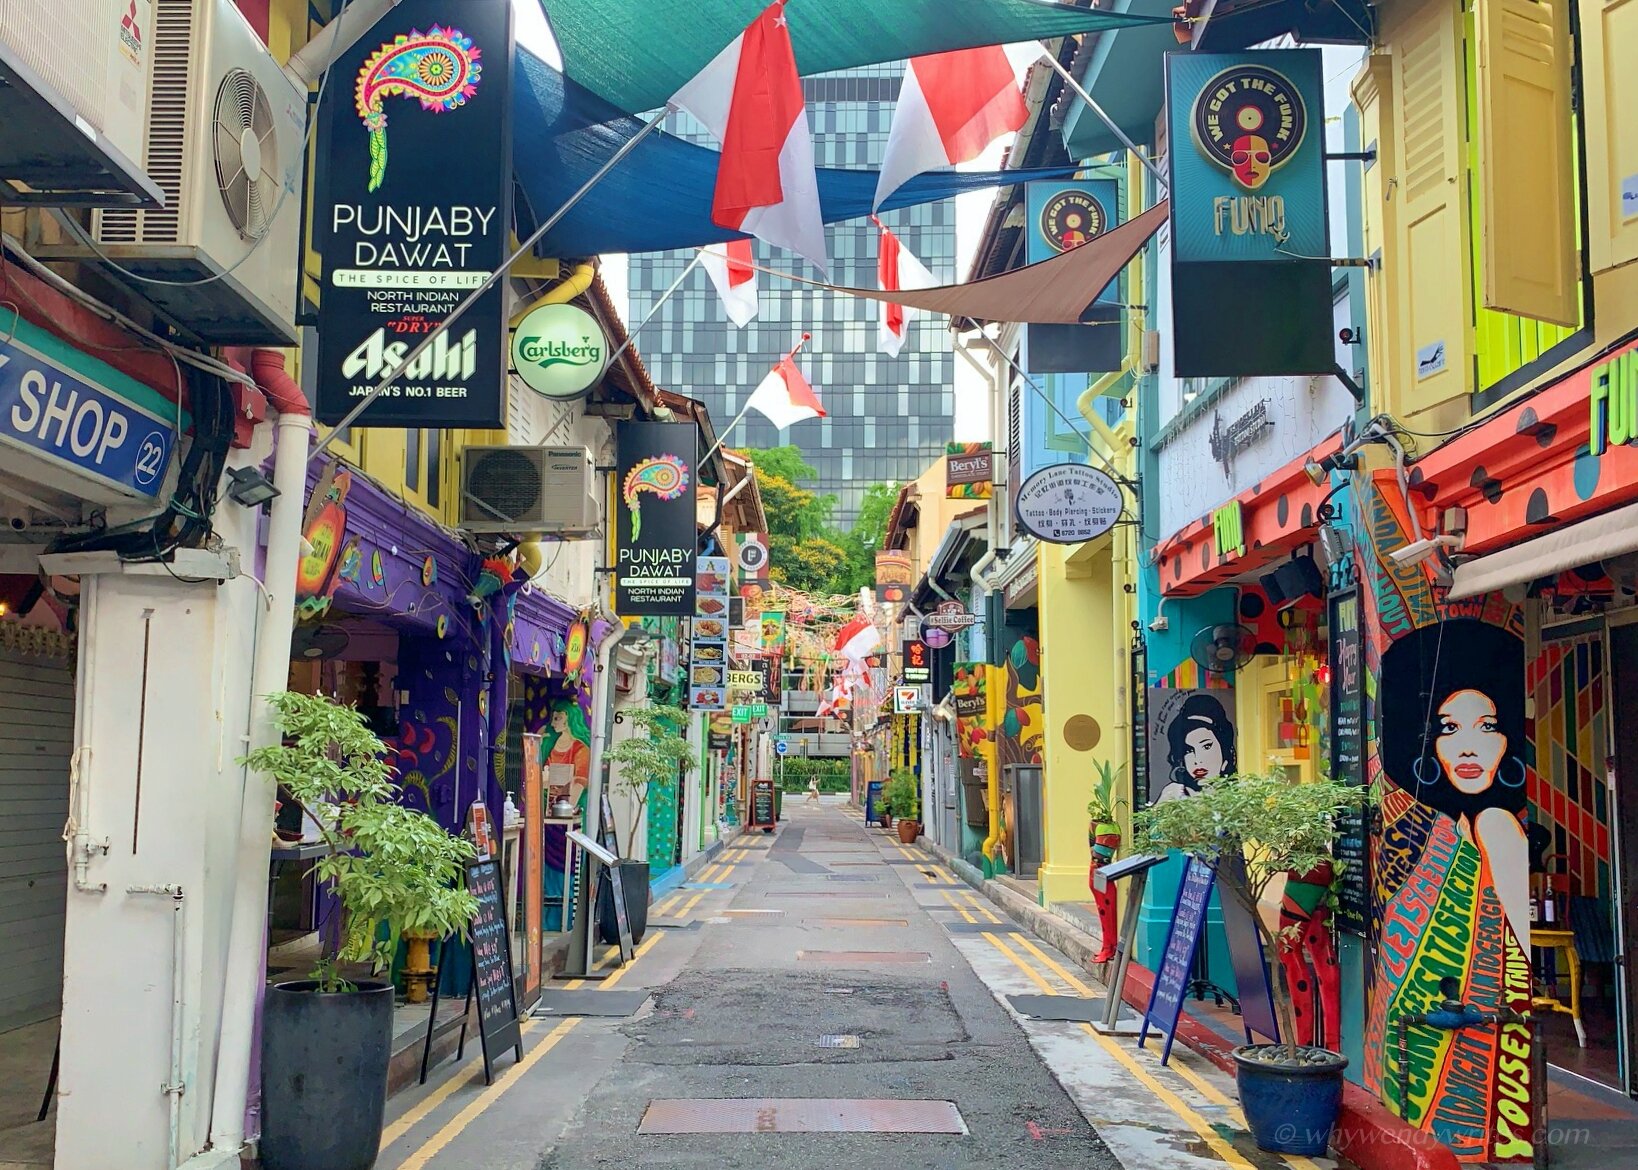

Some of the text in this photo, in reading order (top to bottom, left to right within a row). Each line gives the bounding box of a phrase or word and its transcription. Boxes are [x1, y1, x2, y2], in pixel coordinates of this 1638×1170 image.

[1207, 78, 1293, 143] WE GOT THE FUNK
[332, 203, 496, 242] PUNJABY
[1048, 196, 1099, 236] WE GOT THE FUNK
[355, 241, 473, 268] DAWAT
[338, 273, 366, 283] THE
[376, 274, 419, 284] SPICE
[428, 275, 447, 285] OF
[367, 290, 459, 301] NORTH INDIAN
[370, 303, 455, 313] RESTAURANT
[342, 327, 477, 381] Asahi
[519, 335, 600, 364] Carlsberg
[348, 385, 467, 398] JAPN'S NO.1 BEER
[11, 369, 129, 465] SHOP
[137, 442, 162, 476] 22
[950, 457, 988, 473] Beryl's
[1020, 467, 1119, 502] Memory Lane Tattoo Studio
[619, 548, 693, 566] PUNJABY
[629, 565, 683, 577] DAWAT
[627, 587, 656, 595] NORTH
[630, 595, 682, 603] RESTAURANT
[953, 615, 975, 624] Coffee
[1436, 604, 1481, 620] TOWN
[752, 704, 766, 712] EXIT
[957, 695, 985, 710] Beryl's
[732, 708, 749, 717] EXIT
